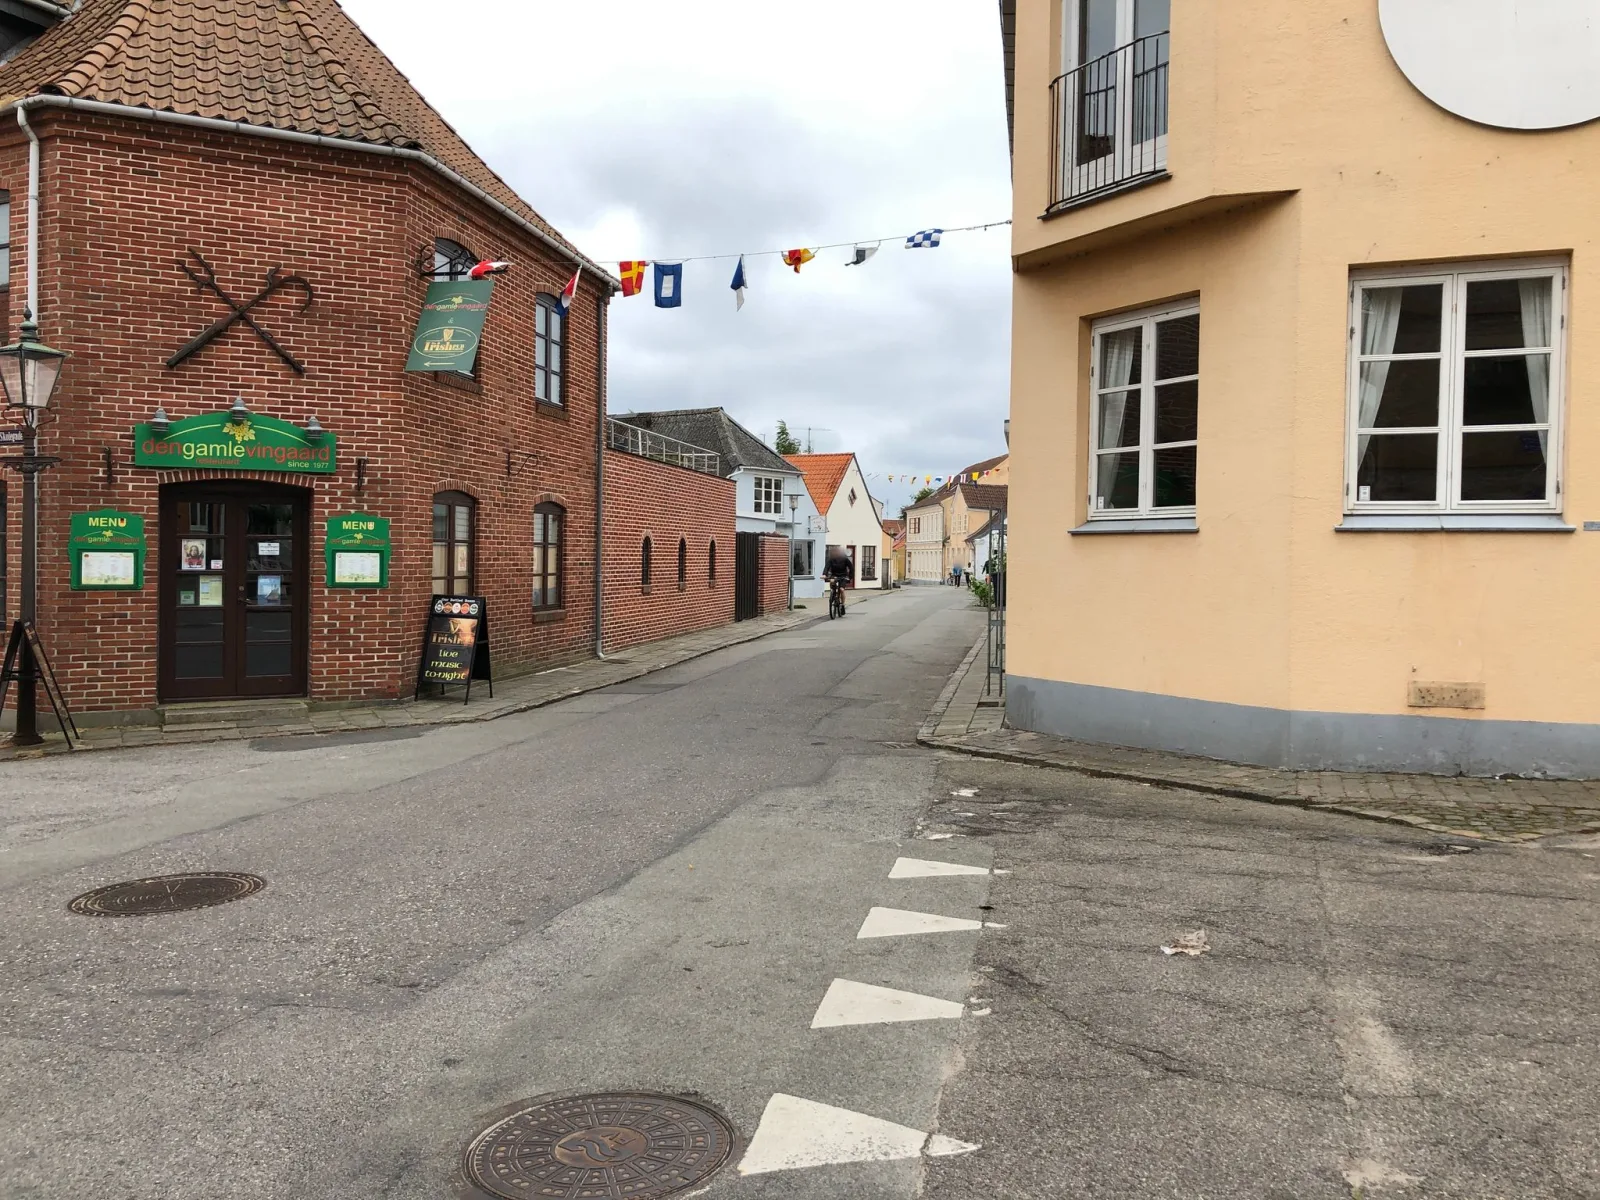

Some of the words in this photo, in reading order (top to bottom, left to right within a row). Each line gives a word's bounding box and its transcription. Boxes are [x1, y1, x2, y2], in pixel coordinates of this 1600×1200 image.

[424, 341, 452, 351] Irish
[287, 460, 310, 468] since
[88, 517, 127, 528] MENU
[342, 521, 375, 531] MENU
[432, 633, 464, 645] Irish
[439, 649, 458, 657] live
[431, 660, 462, 668] music
